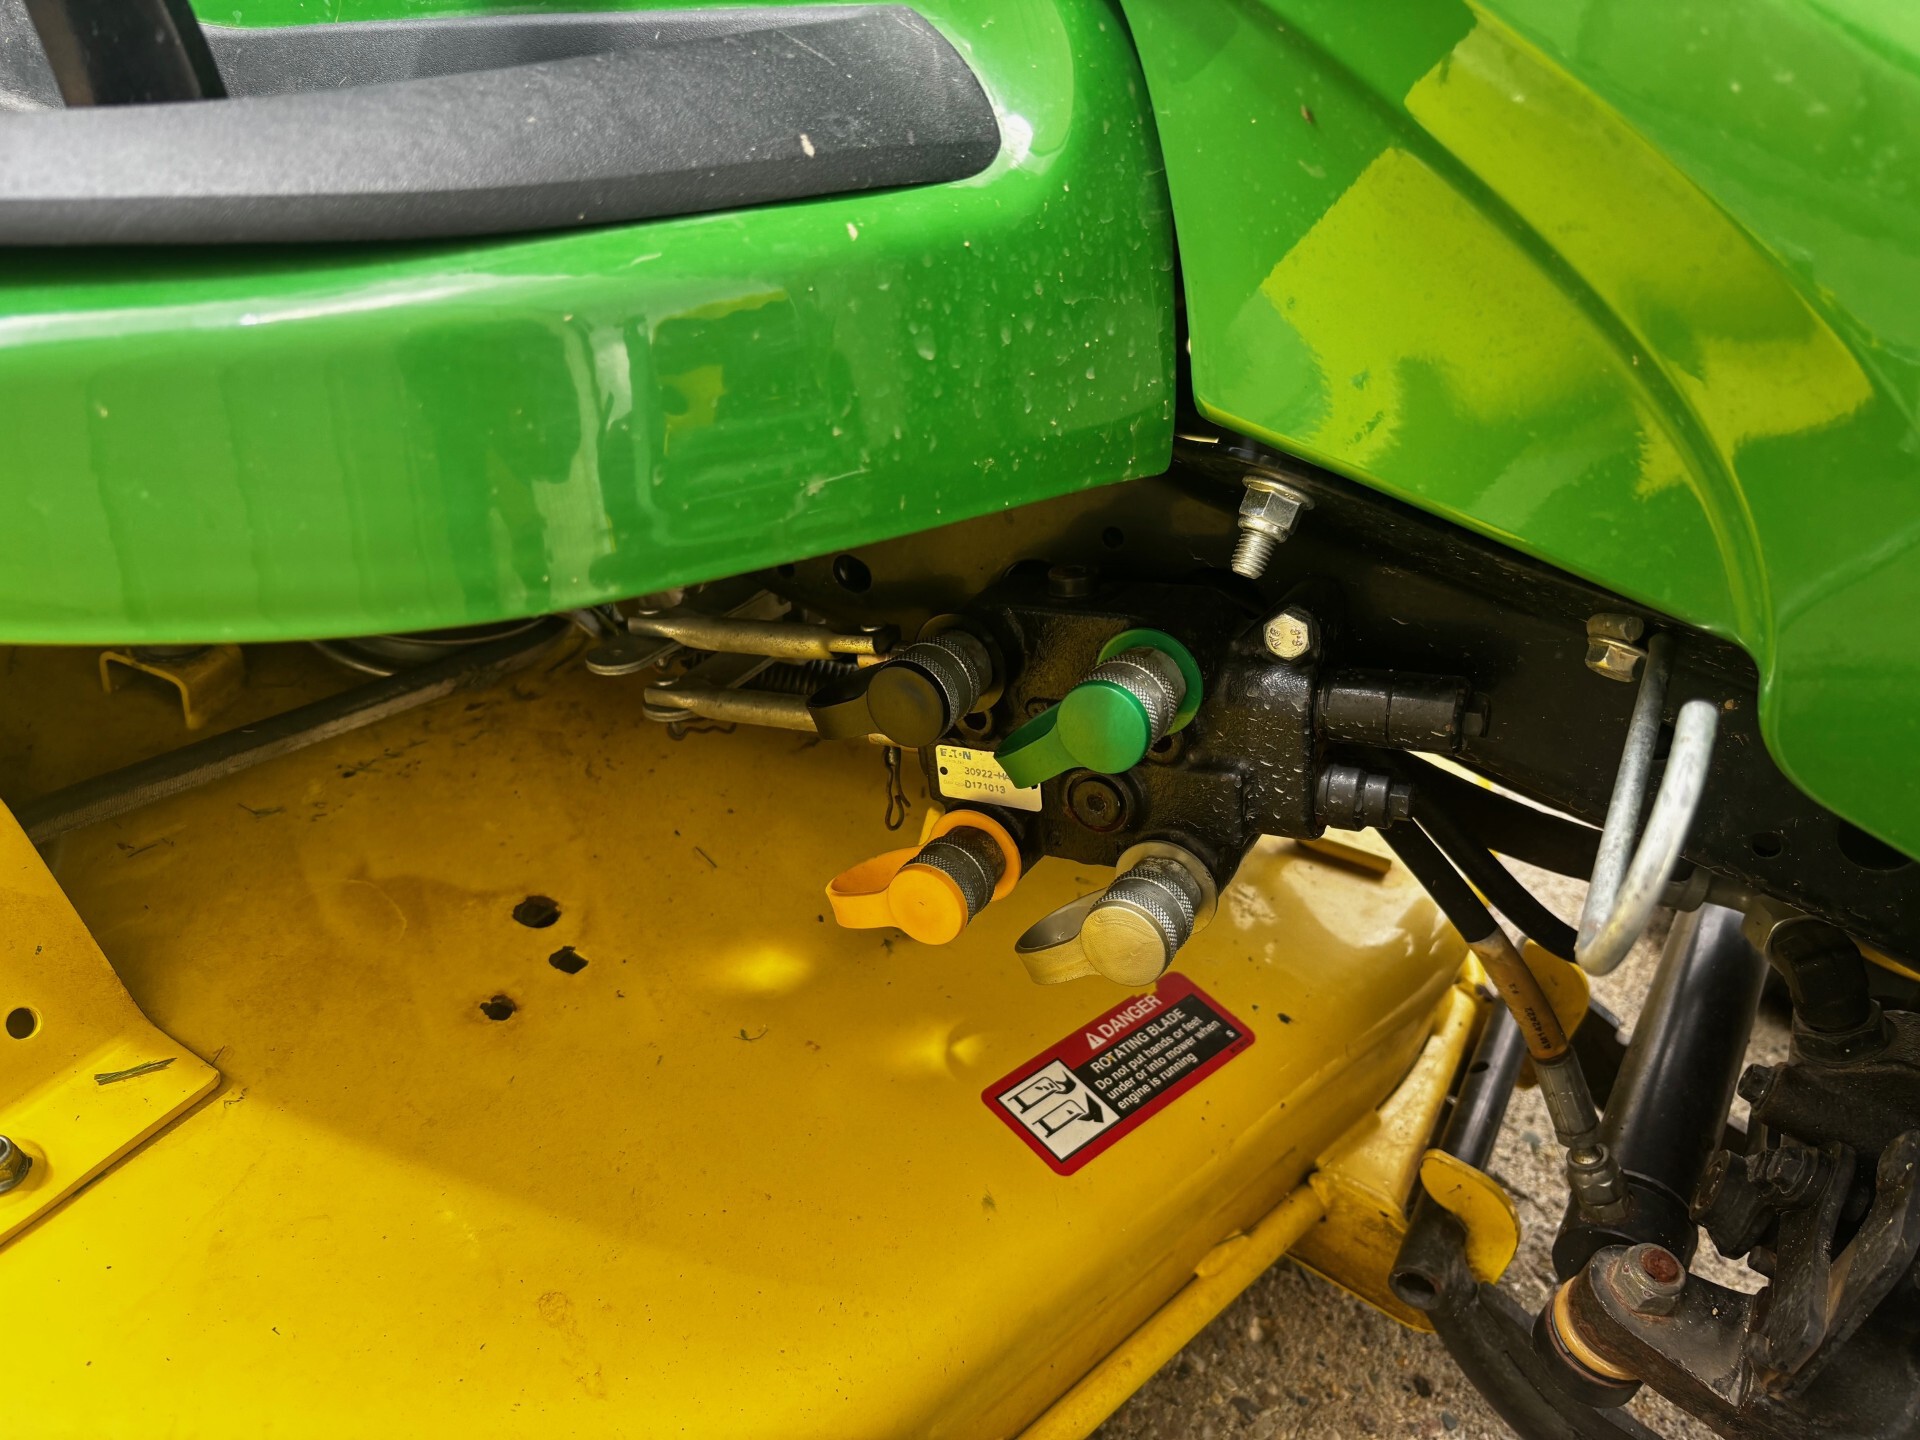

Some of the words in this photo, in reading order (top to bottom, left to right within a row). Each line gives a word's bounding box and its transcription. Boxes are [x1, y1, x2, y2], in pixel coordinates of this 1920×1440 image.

[964, 780, 1006, 794] D171013
[1090, 1032, 1150, 1073] ROTATING
[1145, 1008, 1186, 1037] BLADE
[1098, 995, 1162, 1038] DANGER
[1094, 1077, 1113, 1090] Do
[1111, 1064, 1130, 1080] not
[1128, 1053, 1146, 1071] put
[1142, 1035, 1174, 1058] hands
[1172, 1028, 1185, 1039] or
[1181, 1015, 1203, 1032] feet
[1107, 1076, 1137, 1100] under
[1135, 1069, 1148, 1081] or
[1144, 1056, 1167, 1073] into
[1165, 1035, 1197, 1060] mower
[1194, 1020, 1221, 1040] when
[1117, 1083, 1151, 1109] engine
[1148, 1076, 1162, 1088] is
[1159, 1052, 1198, 1081] running
